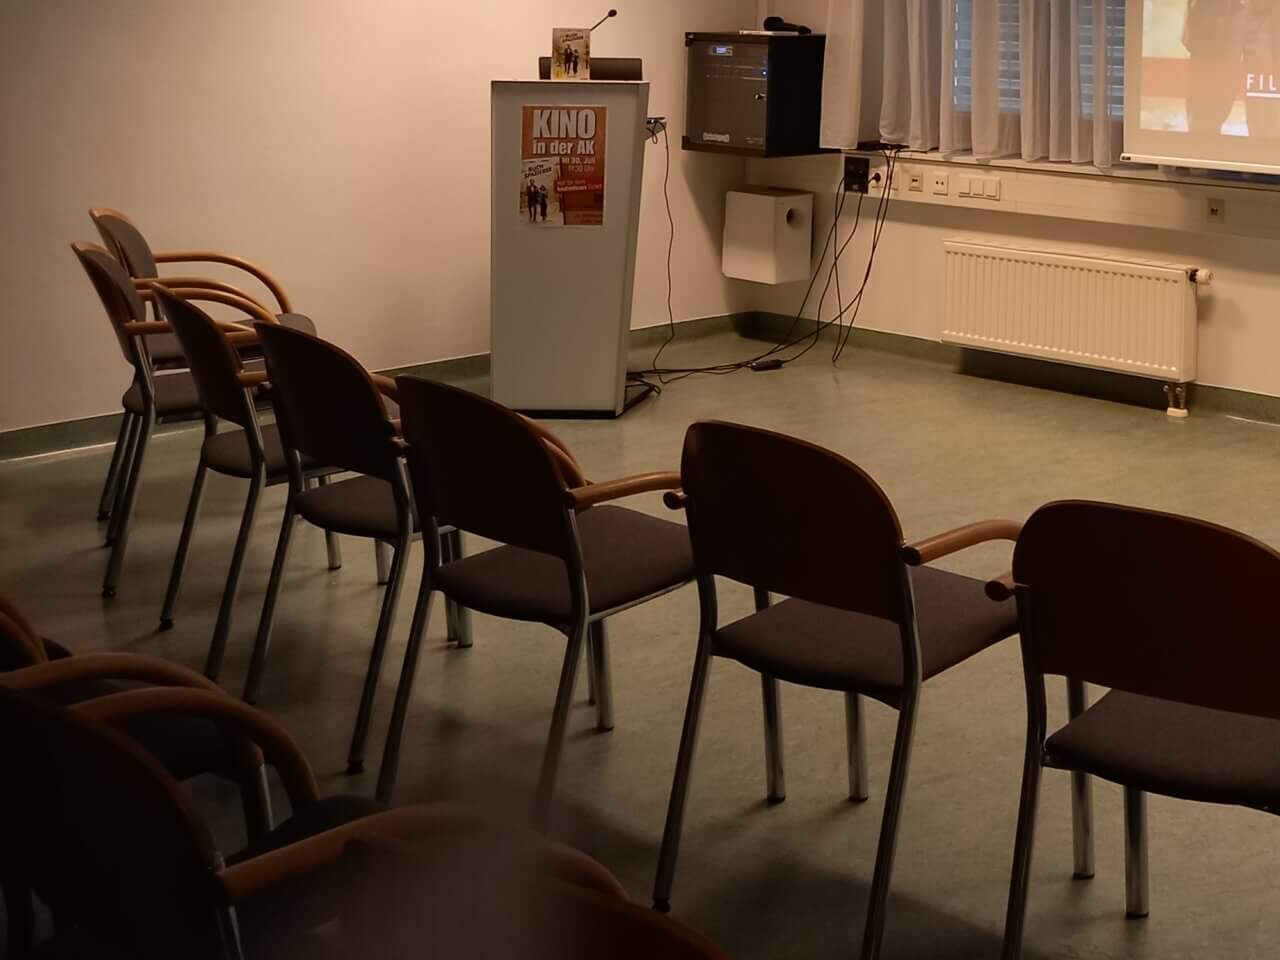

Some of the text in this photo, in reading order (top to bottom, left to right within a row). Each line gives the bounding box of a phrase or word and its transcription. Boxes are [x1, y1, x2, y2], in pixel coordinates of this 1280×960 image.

[532, 109, 596, 139] KINO
[532, 140, 595, 155] in der AK
